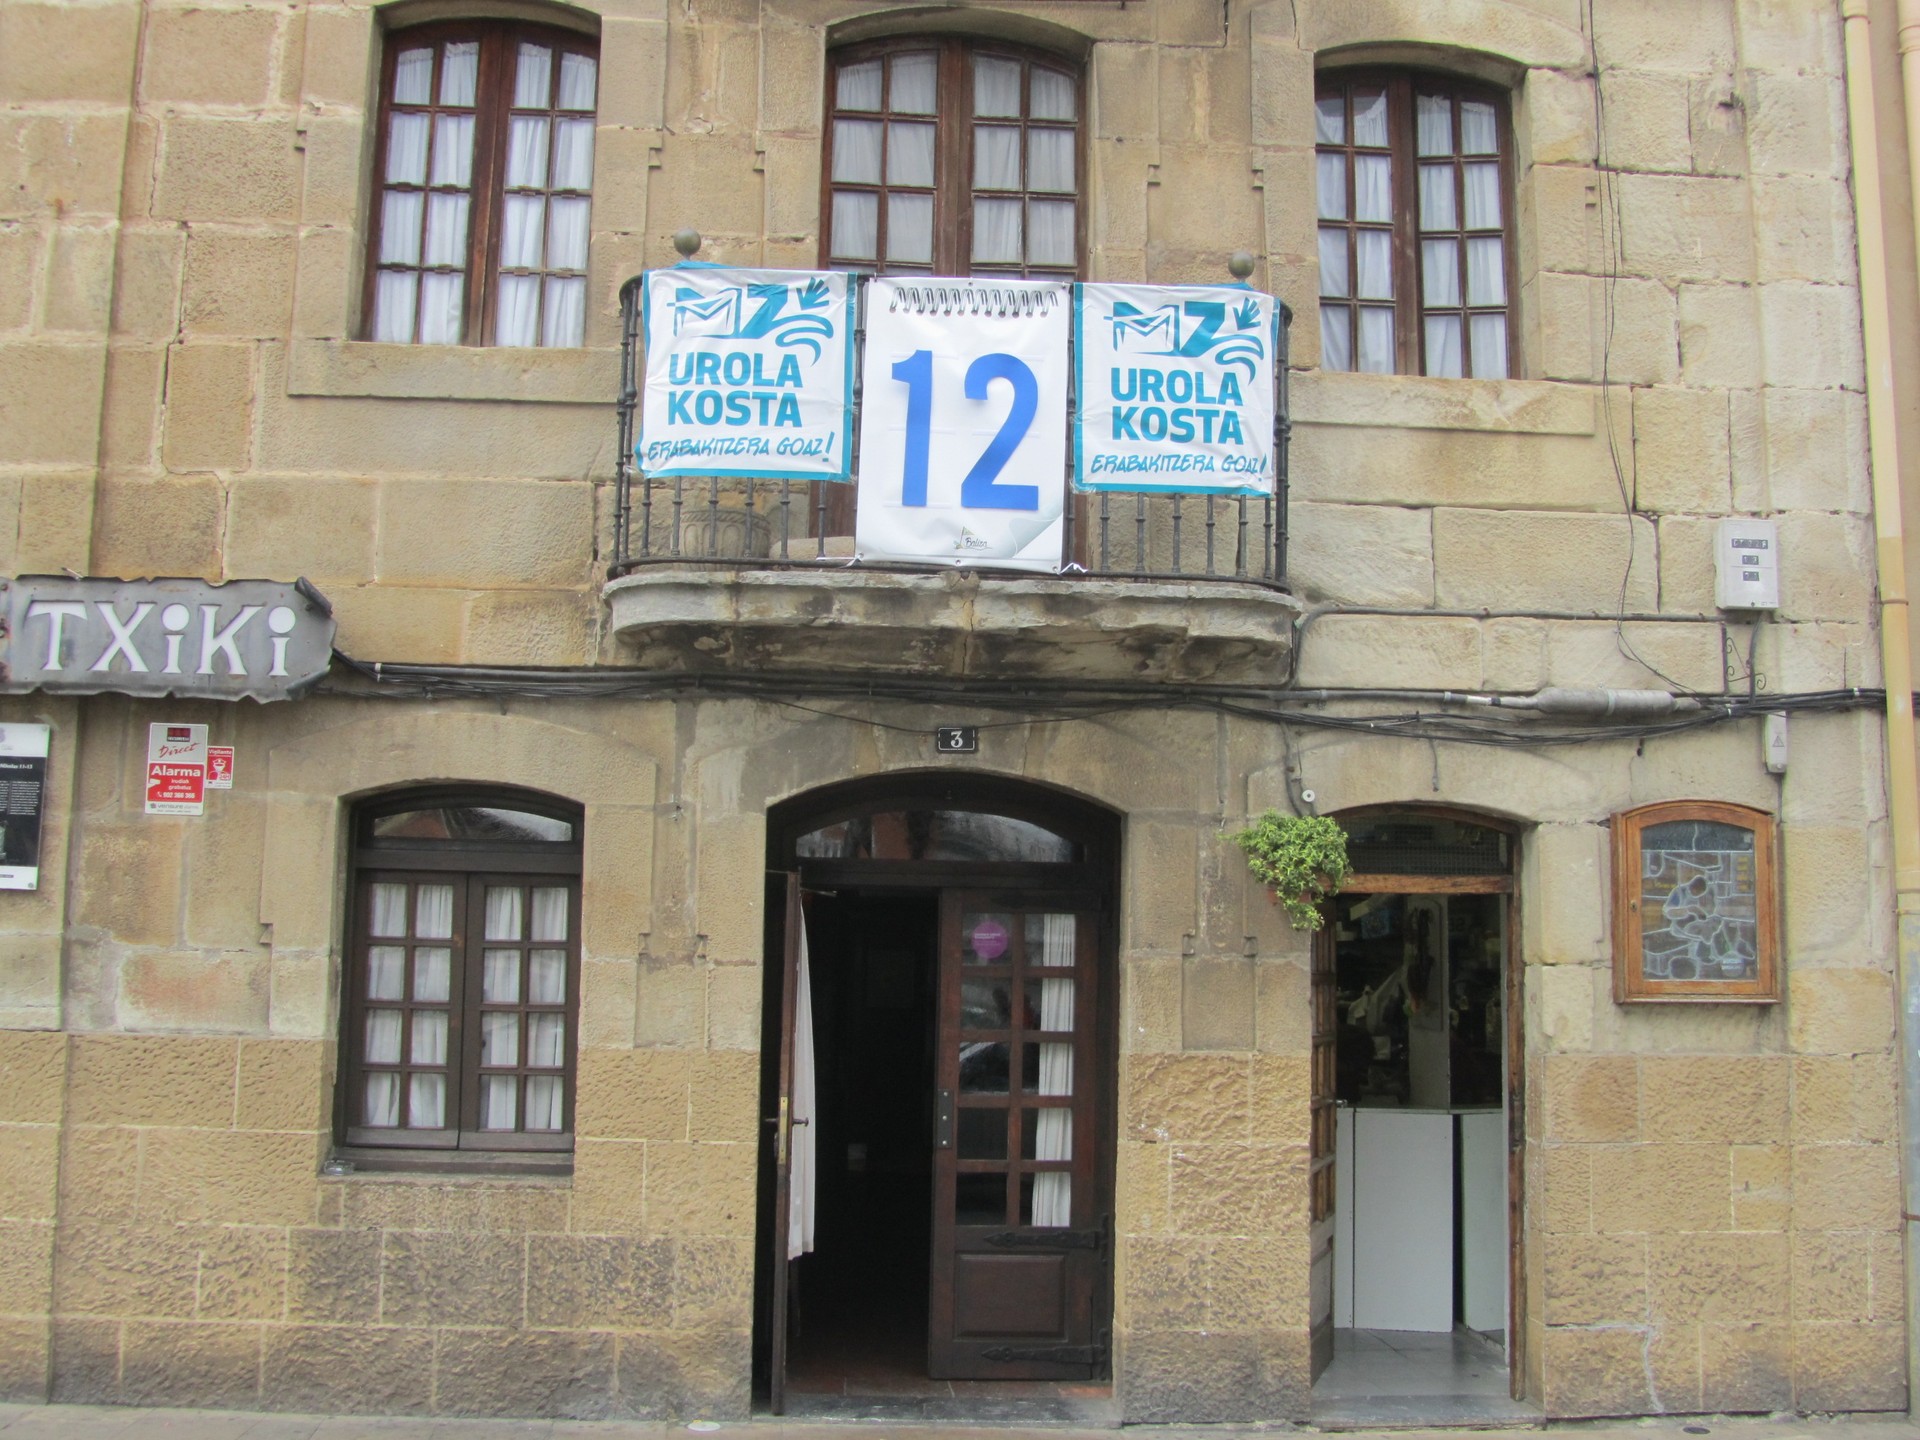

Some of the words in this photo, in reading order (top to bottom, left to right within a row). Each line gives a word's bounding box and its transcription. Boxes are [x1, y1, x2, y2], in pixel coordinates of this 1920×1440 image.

[669, 352, 803, 388] UROLA
[1111, 367, 1243, 406] UROLA
[668, 389, 802, 427] KOSTA
[892, 349, 1039, 511] 12
[1112, 406, 1244, 445] KOSTA
[648, 437, 769, 461] ERABAKITZERA
[777, 431, 835, 462] GOAZ!
[1090, 453, 1215, 474] ERABAKITZERA
[1221, 452, 1268, 482] GOAZ!
[159, 742, 200, 758] Direct
[950, 730, 963, 748] 3
[151, 765, 201, 777] Alarma
